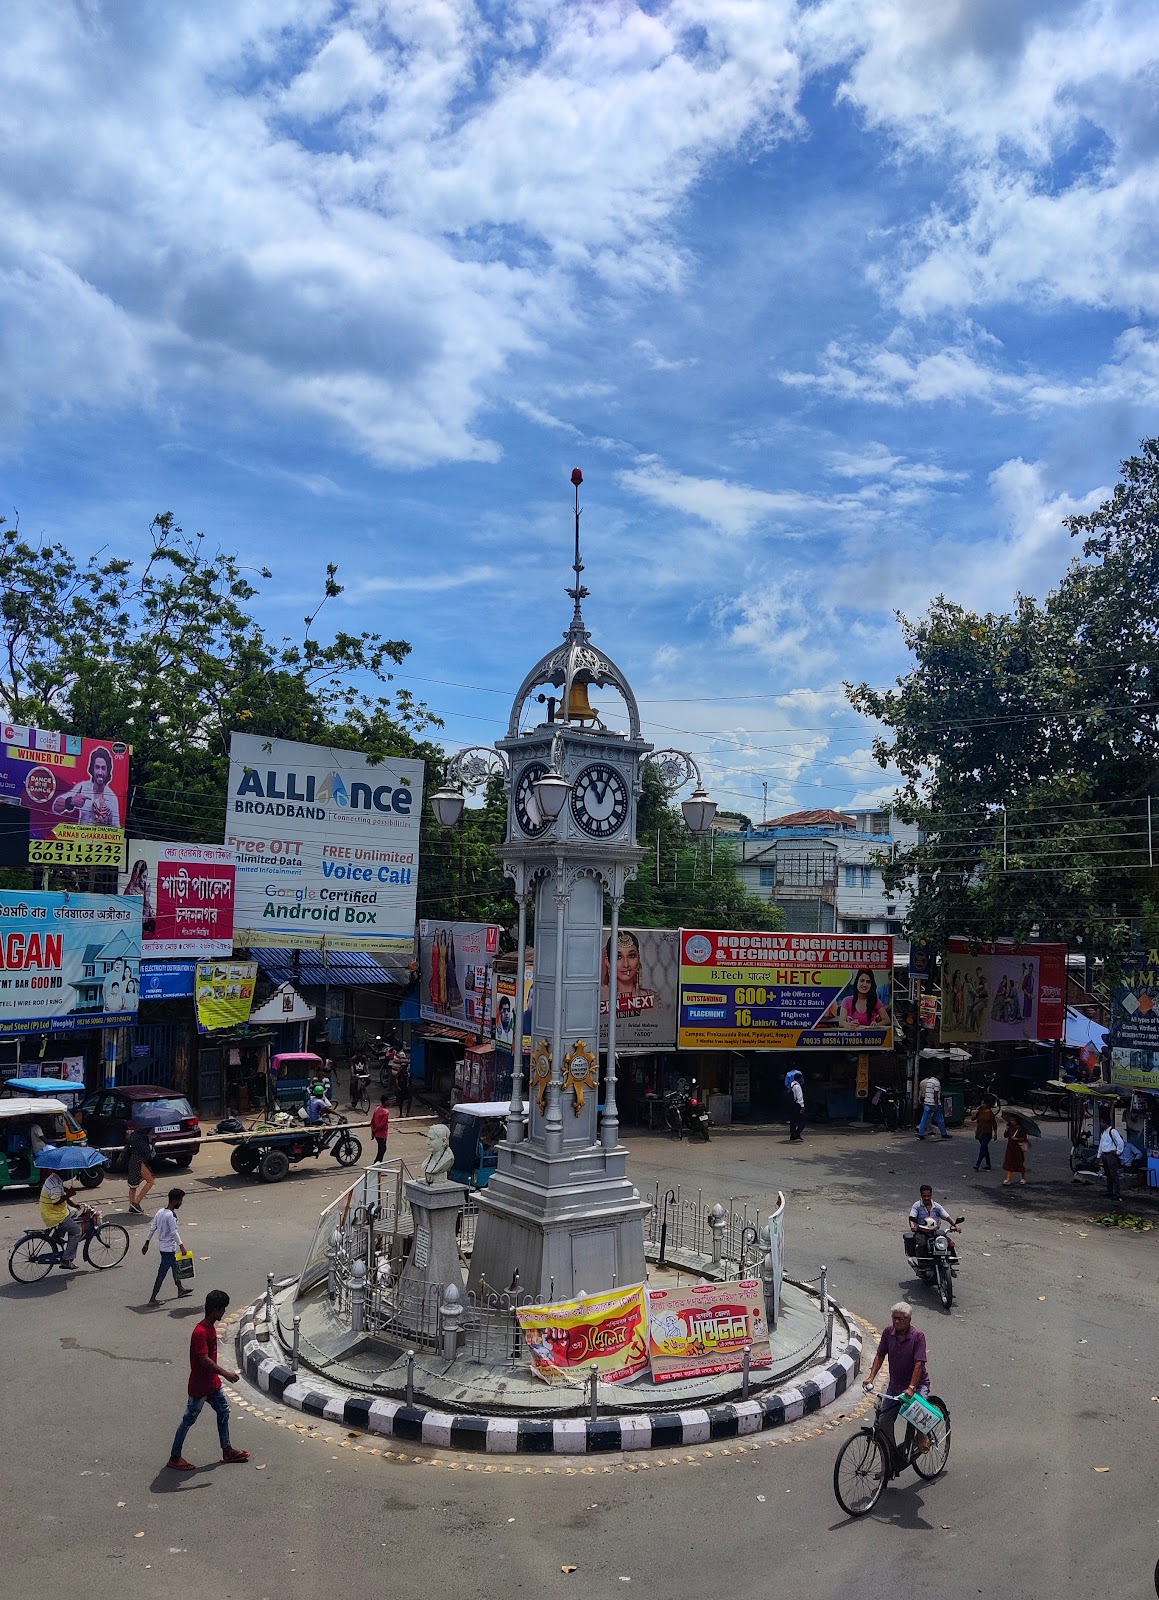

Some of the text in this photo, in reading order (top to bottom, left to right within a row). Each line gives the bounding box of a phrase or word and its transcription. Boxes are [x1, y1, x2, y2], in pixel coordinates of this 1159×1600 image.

[17, 749, 65, 765] WINNER OF
[30, 775, 52, 784] DANCE
[235, 800, 326, 821] BROADBAND
[333, 814, 411, 828] Connecting possibilities
[58, 831, 122, 841] ARNAB CHAKRABORTY
[29, 841, 122, 853] 278313242
[227, 837, 304, 856] Free OTT
[29, 852, 121, 863] 003156779
[279, 855, 302, 866] Data
[322, 845, 414, 865] FREE Unlimited
[260, 866, 302, 876] Infotainment
[322, 861, 412, 885] Voice Call
[192, 875, 232, 900] প্যালেস
[265, 884, 378, 904] Google Certified
[31, 907, 46, 918] বার
[262, 902, 377, 924] Android Box
[717, 936, 889, 951] HOOGHLY ENGINEERING
[0, 933, 63, 970] GAN
[715, 949, 727, 960] &
[731, 949, 825, 962] TECHNOLOGY
[829, 951, 888, 963] COLLEGE
[711, 970, 743, 980] B.Tech
[777, 971, 822, 985] HETC
[15, 979, 29, 988] BAR
[686, 995, 723, 1003] OUTSTANDING
[734, 988, 777, 1005] 600+
[690, 1010, 725, 1018] PLACEMENT
[734, 1009, 751, 1026] 16
[781, 1011, 810, 1019] Highest
[14, 1022, 30, 1031] Steel
[781, 1019, 812, 1027] Package
[687, 1314, 749, 1347] সম্মেলন
